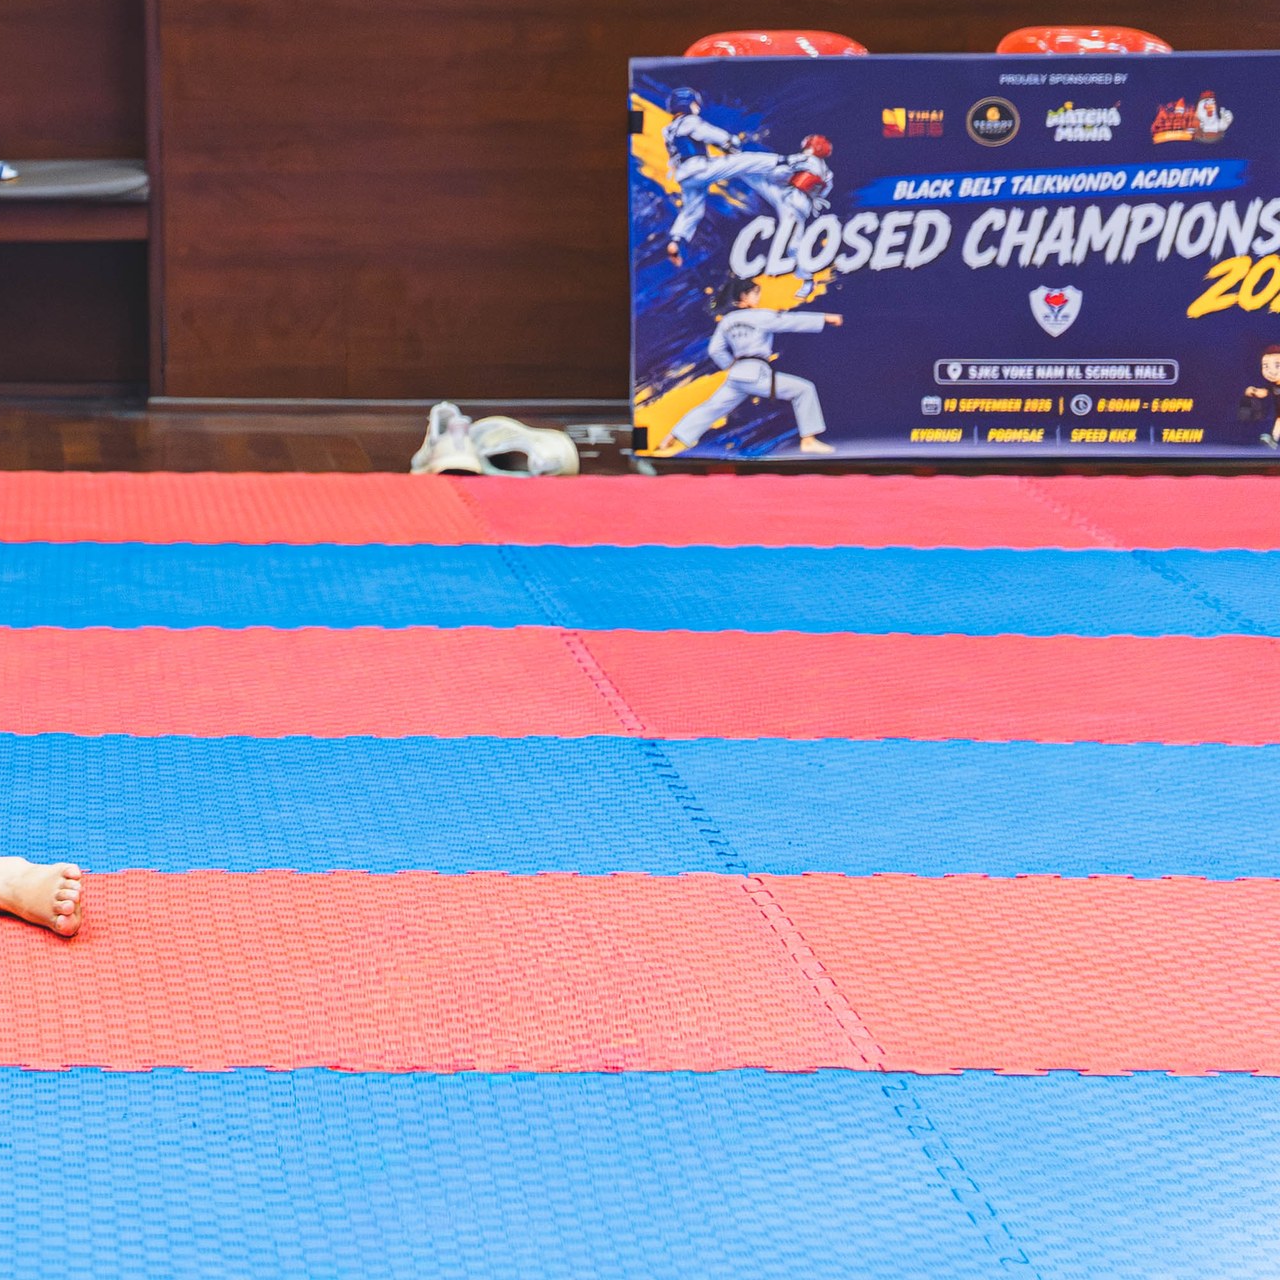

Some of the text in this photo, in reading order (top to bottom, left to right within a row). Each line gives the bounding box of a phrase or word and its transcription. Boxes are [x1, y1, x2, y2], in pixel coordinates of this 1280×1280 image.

[999, 73, 1128, 85] PROUDLY SPONSORED BY
[1045, 106, 1122, 128] MATCHA
[893, 166, 1220, 201] BLACK BELT TAEKWONDO ACADEMY
[729, 209, 953, 280] CLOSED
[968, 365, 1167, 379] SJKC YOKE NAM KL SCHOOL HALL
[959, 398, 1022, 412] SEPTEMBER
[987, 428, 1044, 442] POOMSAE
[1071, 428, 1108, 442] SPEED
[1108, 428, 1137, 442] KICK
